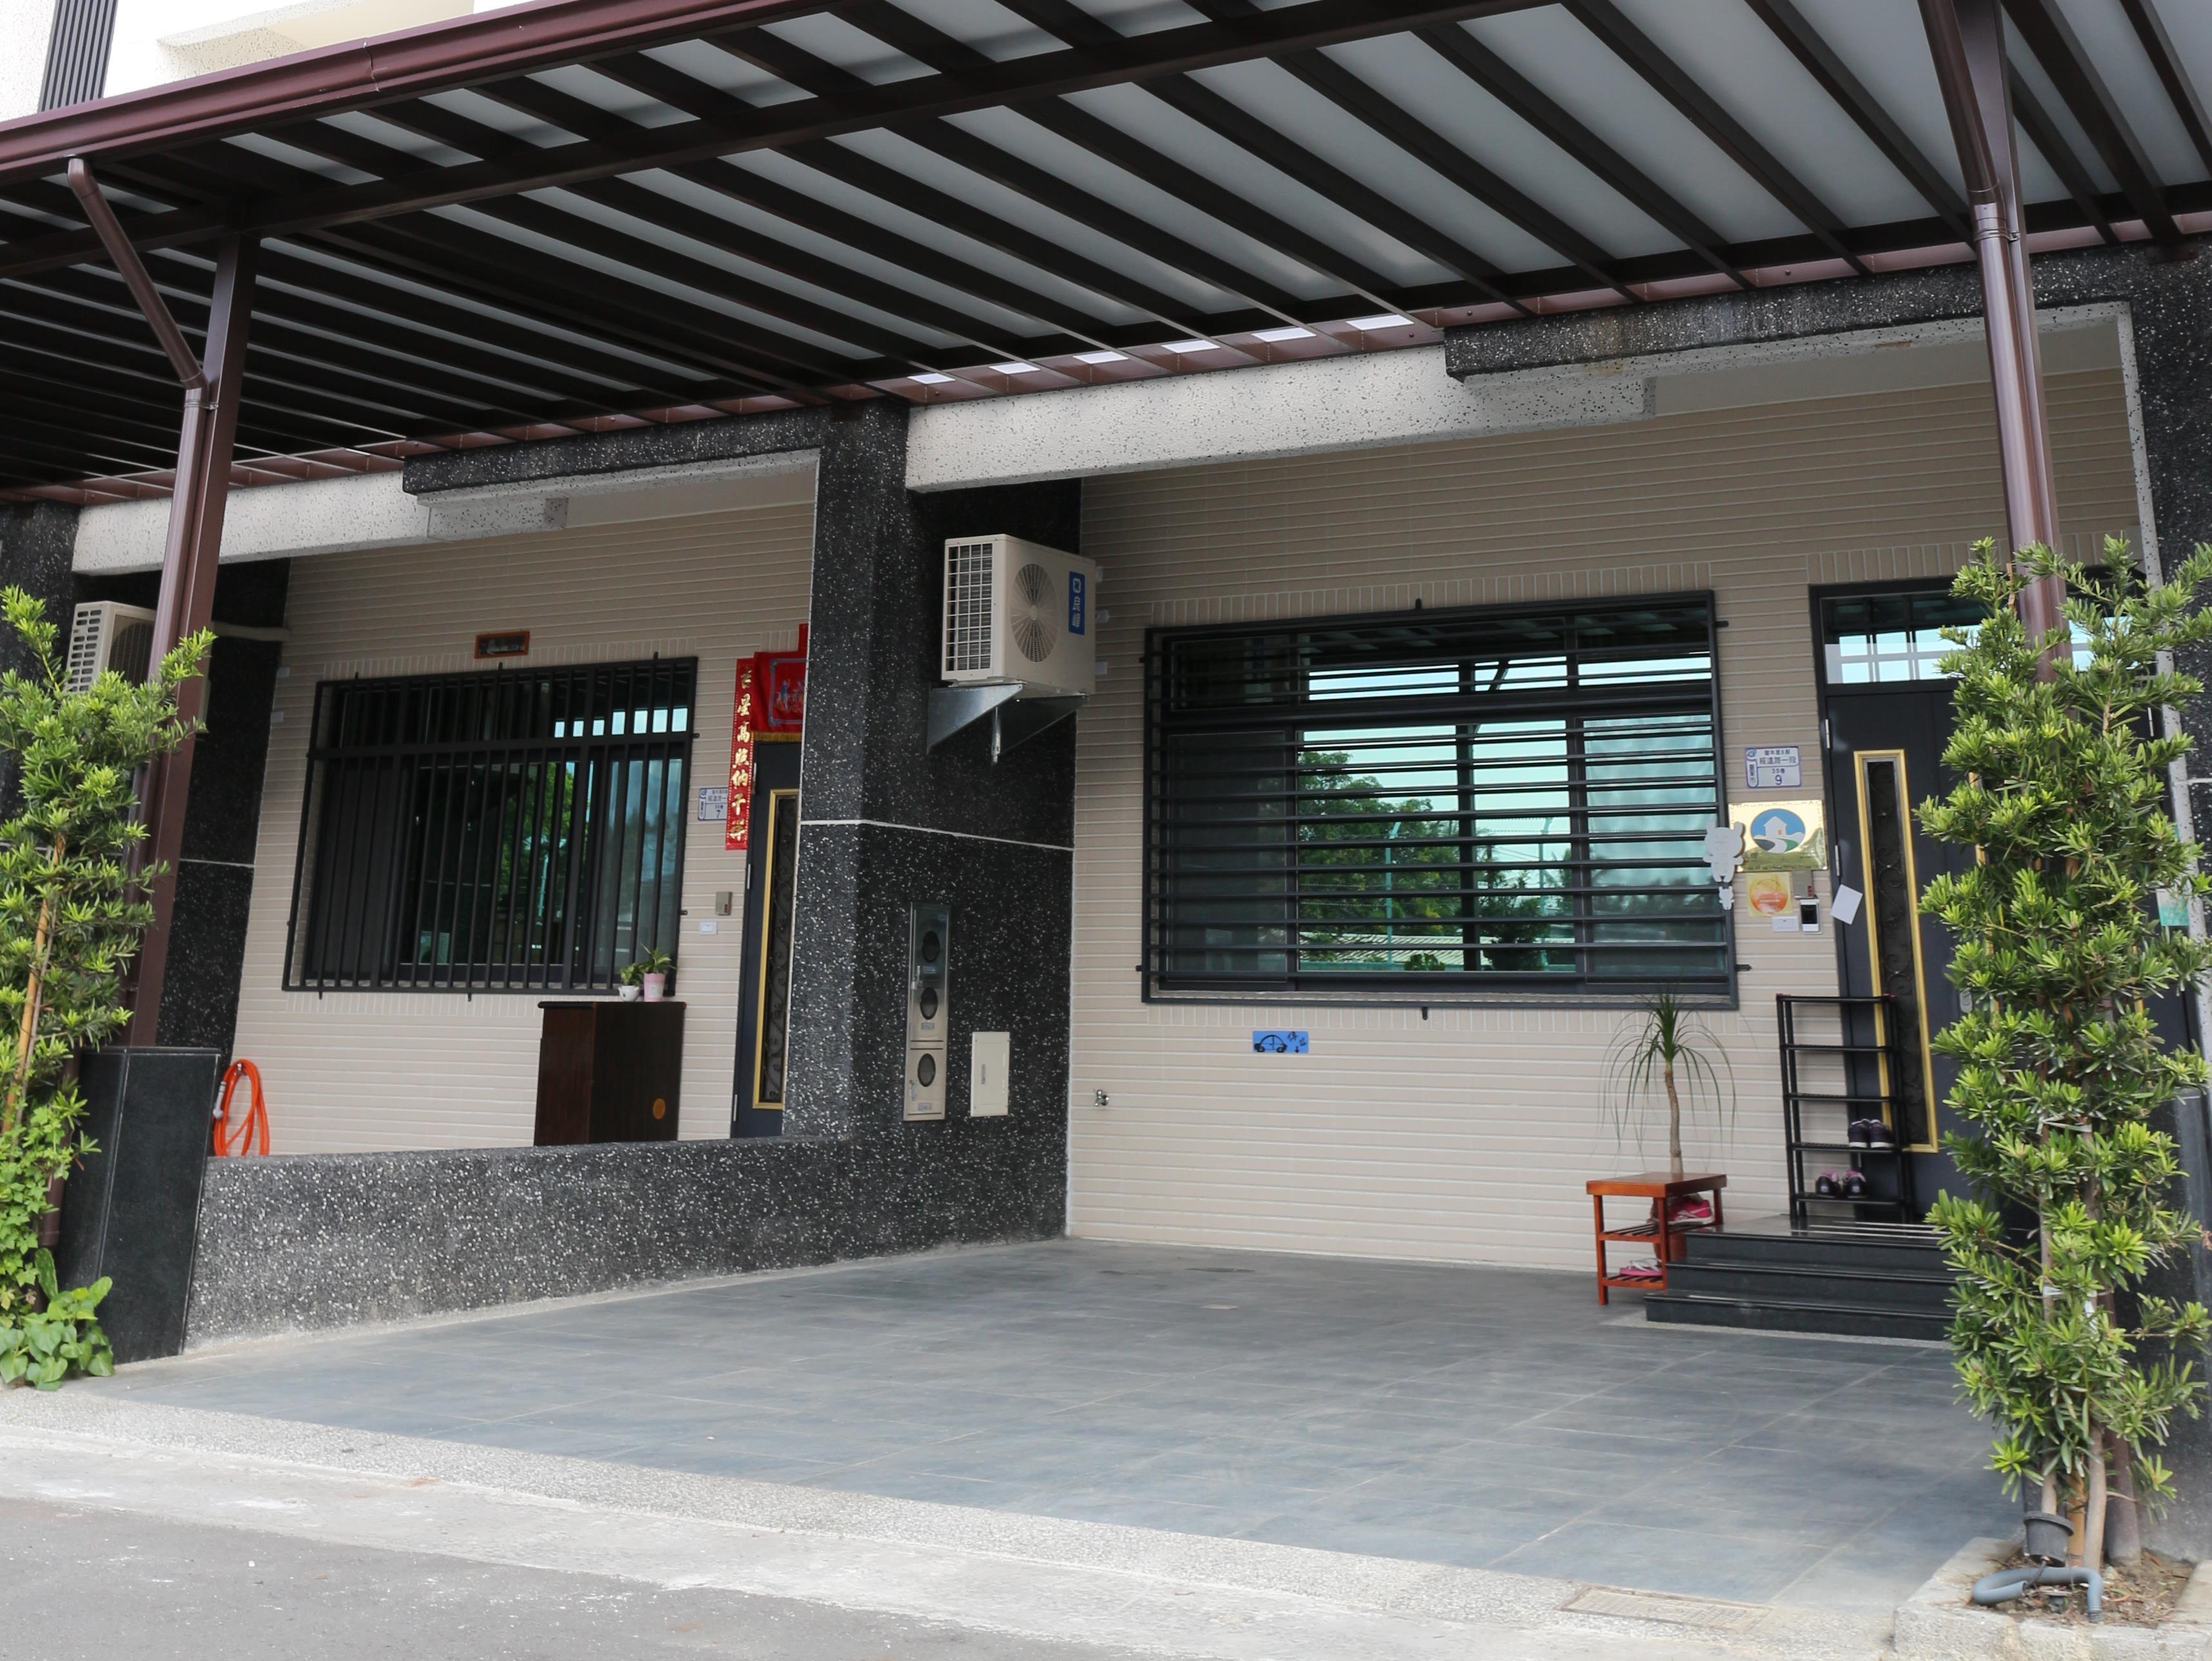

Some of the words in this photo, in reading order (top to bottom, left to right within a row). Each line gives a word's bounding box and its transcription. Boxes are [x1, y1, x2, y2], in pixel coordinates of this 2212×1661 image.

[730, 667, 752, 841] 吉星高照納千祥
[1775, 774, 1782, 785] 9
[716, 809, 721, 818] 7
